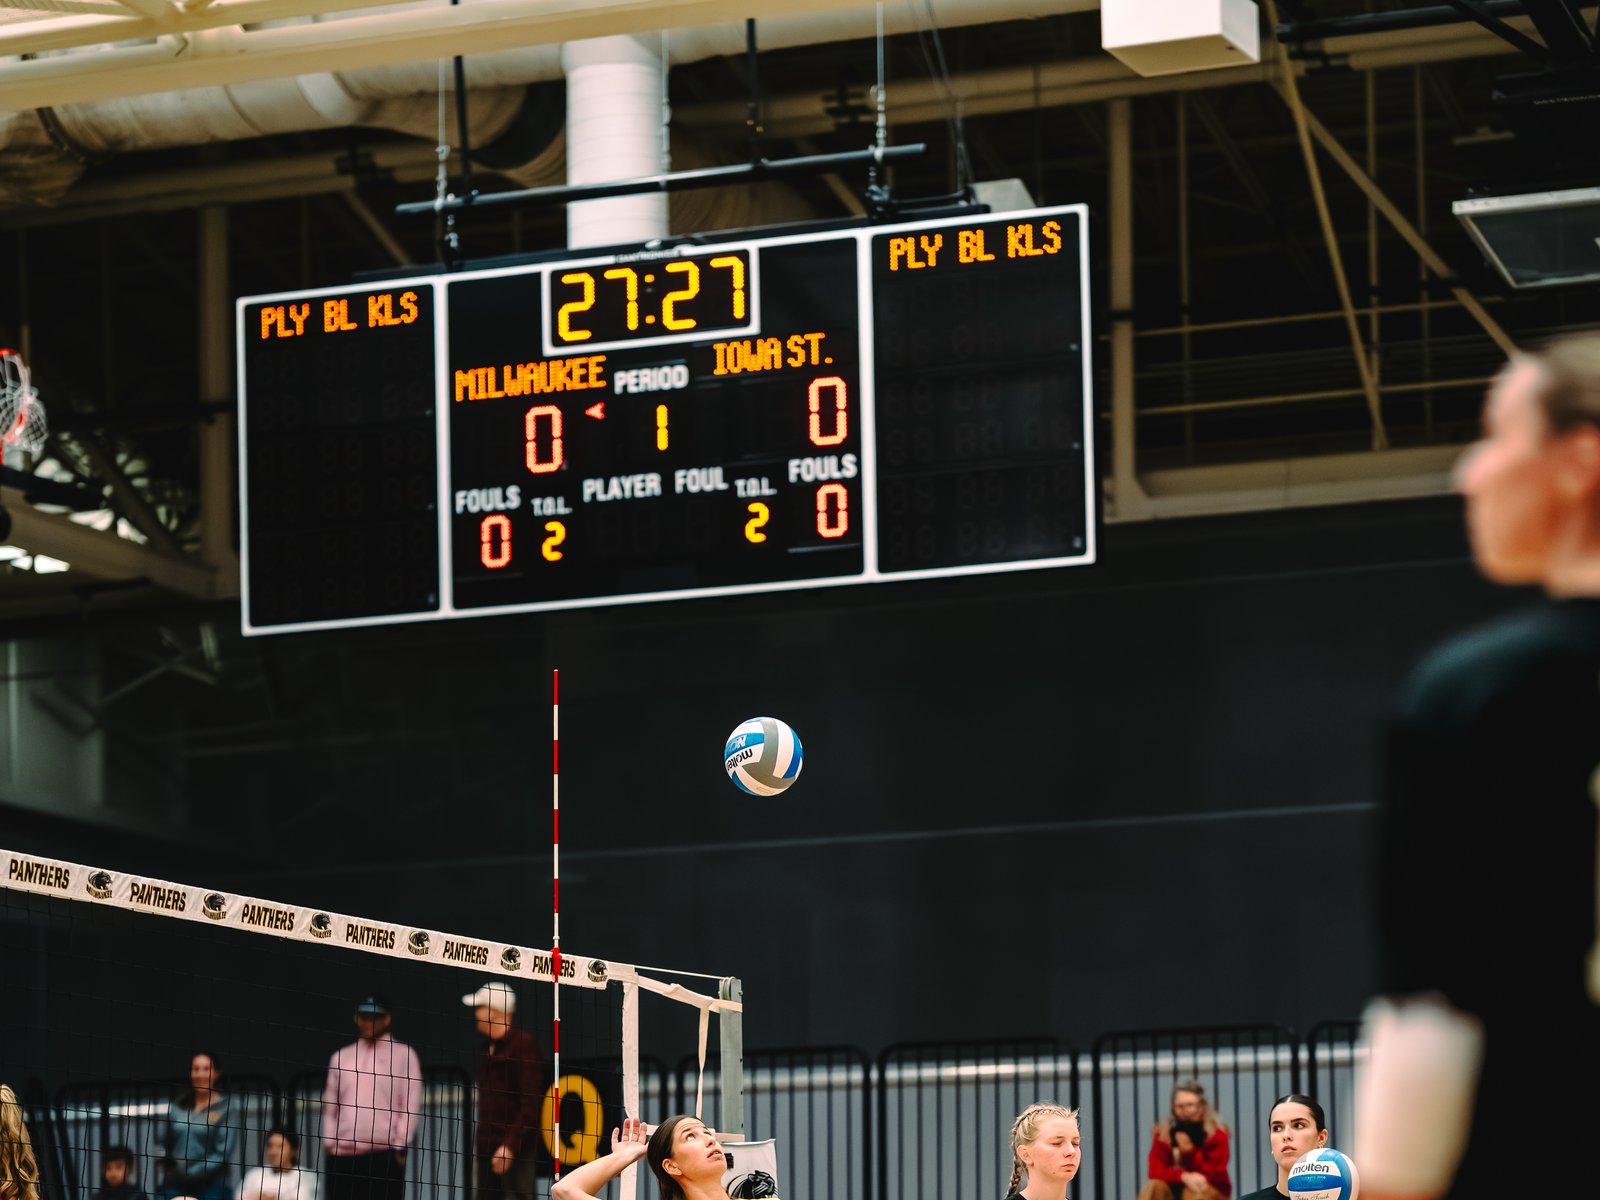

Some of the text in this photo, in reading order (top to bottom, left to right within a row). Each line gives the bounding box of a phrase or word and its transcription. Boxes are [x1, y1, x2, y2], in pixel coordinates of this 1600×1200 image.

[888, 221, 1062, 271] PLY BL KLS
[260, 291, 419, 339] PLY BL KLS
[558, 256, 745, 342] 27:27
[454, 355, 608, 402] MILWAUKEE
[613, 365, 690, 395] PERIOD
[656, 404, 669, 451] 1
[808, 376, 848, 446] 0
[525, 404, 563, 474] 0
[582, 466, 729, 503] PLAYER FOUL
[788, 453, 858, 483] FOULS
[455, 486, 521, 514] FOULS
[816, 483, 849, 539] 0
[480, 514, 512, 569] 0
[541, 521, 566, 562] 2
[744, 502, 770, 543] 2
[8, 858, 70, 890] PANTHERS
[129, 882, 187, 912] PANTHERS
[240, 903, 295, 931] PANTHERS
[345, 923, 396, 949] PANTHERS
[442, 939, 489, 965] PANTHERS
[532, 954, 576, 978] PANTERS
[1292, 1162, 1330, 1176] molten
